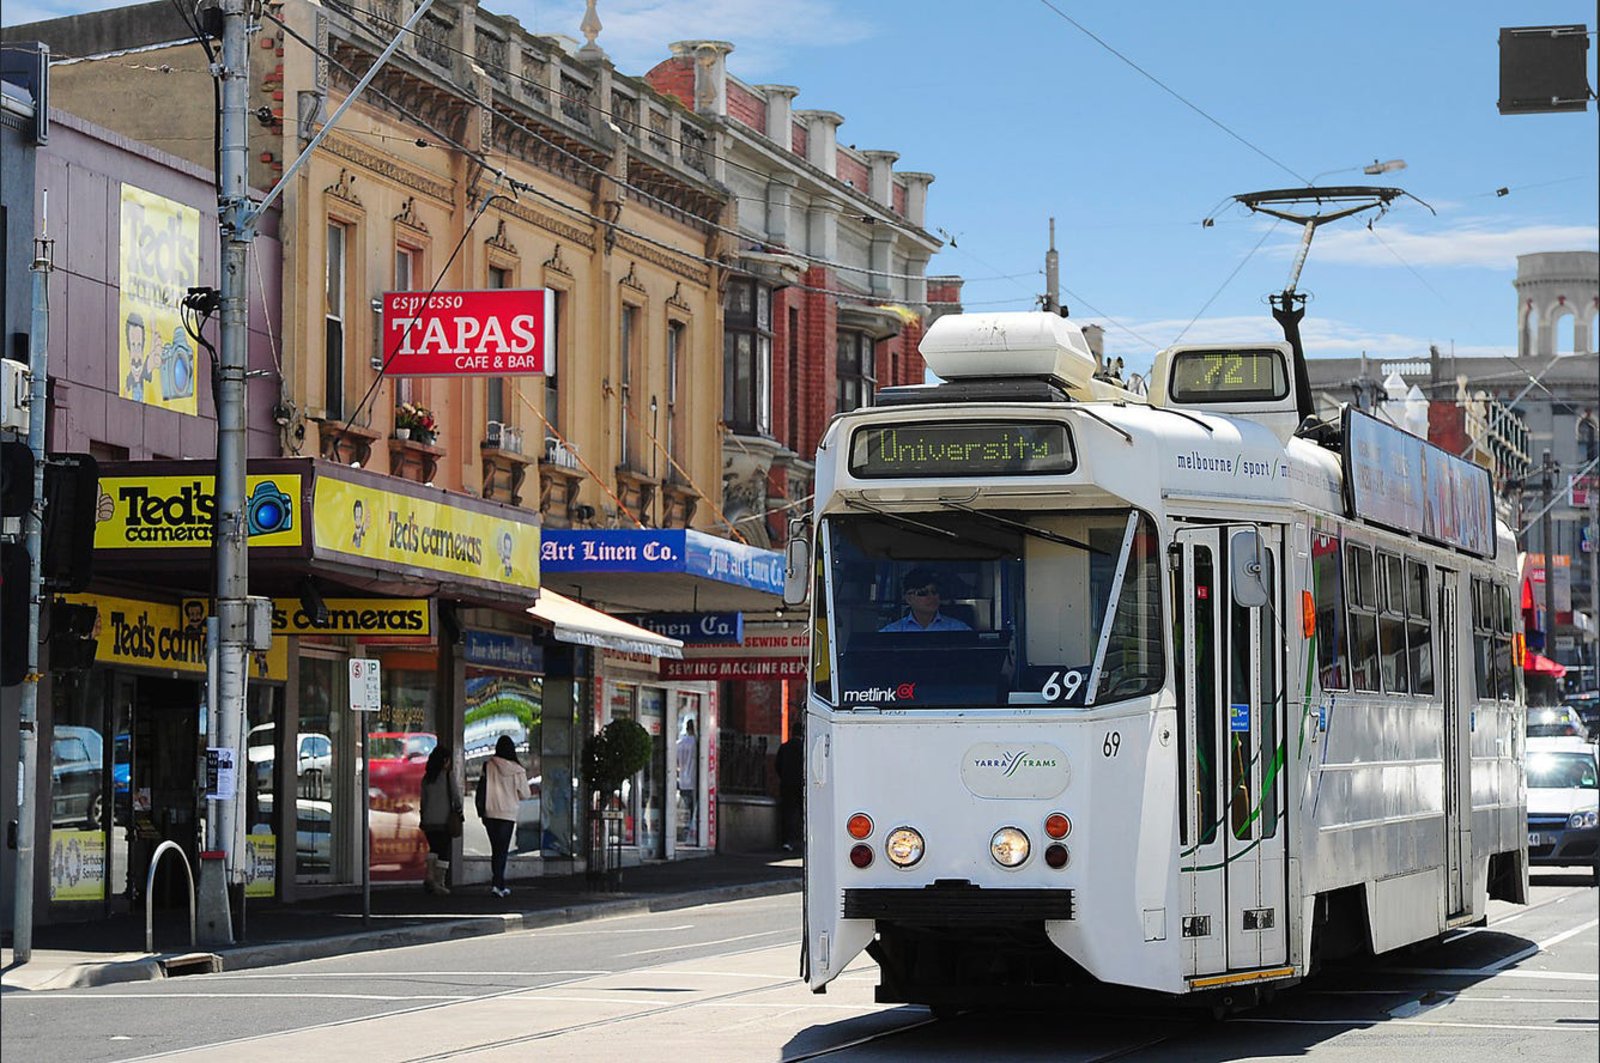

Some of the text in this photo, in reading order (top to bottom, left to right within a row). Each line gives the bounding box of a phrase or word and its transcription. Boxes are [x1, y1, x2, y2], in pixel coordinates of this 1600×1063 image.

[122, 200, 195, 288] Ted's
[392, 295, 463, 317] espresso
[392, 314, 536, 355] TAPAS
[455, 355, 535, 369] CAFE & BAR
[880, 430, 1048, 462] University
[1177, 452, 1232, 472] melbourne
[1243, 461, 1269, 478] sport
[119, 481, 216, 527] Ted's
[388, 511, 483, 566] Ted's cameras
[540, 541, 678, 561] Art Linen Co.
[111, 610, 155, 659] Ted's
[700, 615, 735, 636] Co.
[744, 635, 788, 648] SEWING
[668, 663, 717, 675] SEWING
[720, 662, 777, 675] MACHINE
[844, 687, 897, 702] metlink
[1041, 670, 1083, 701] 69
[1102, 731, 1121, 758] 69
[974, 759, 1056, 767] YARRA TRAMS
